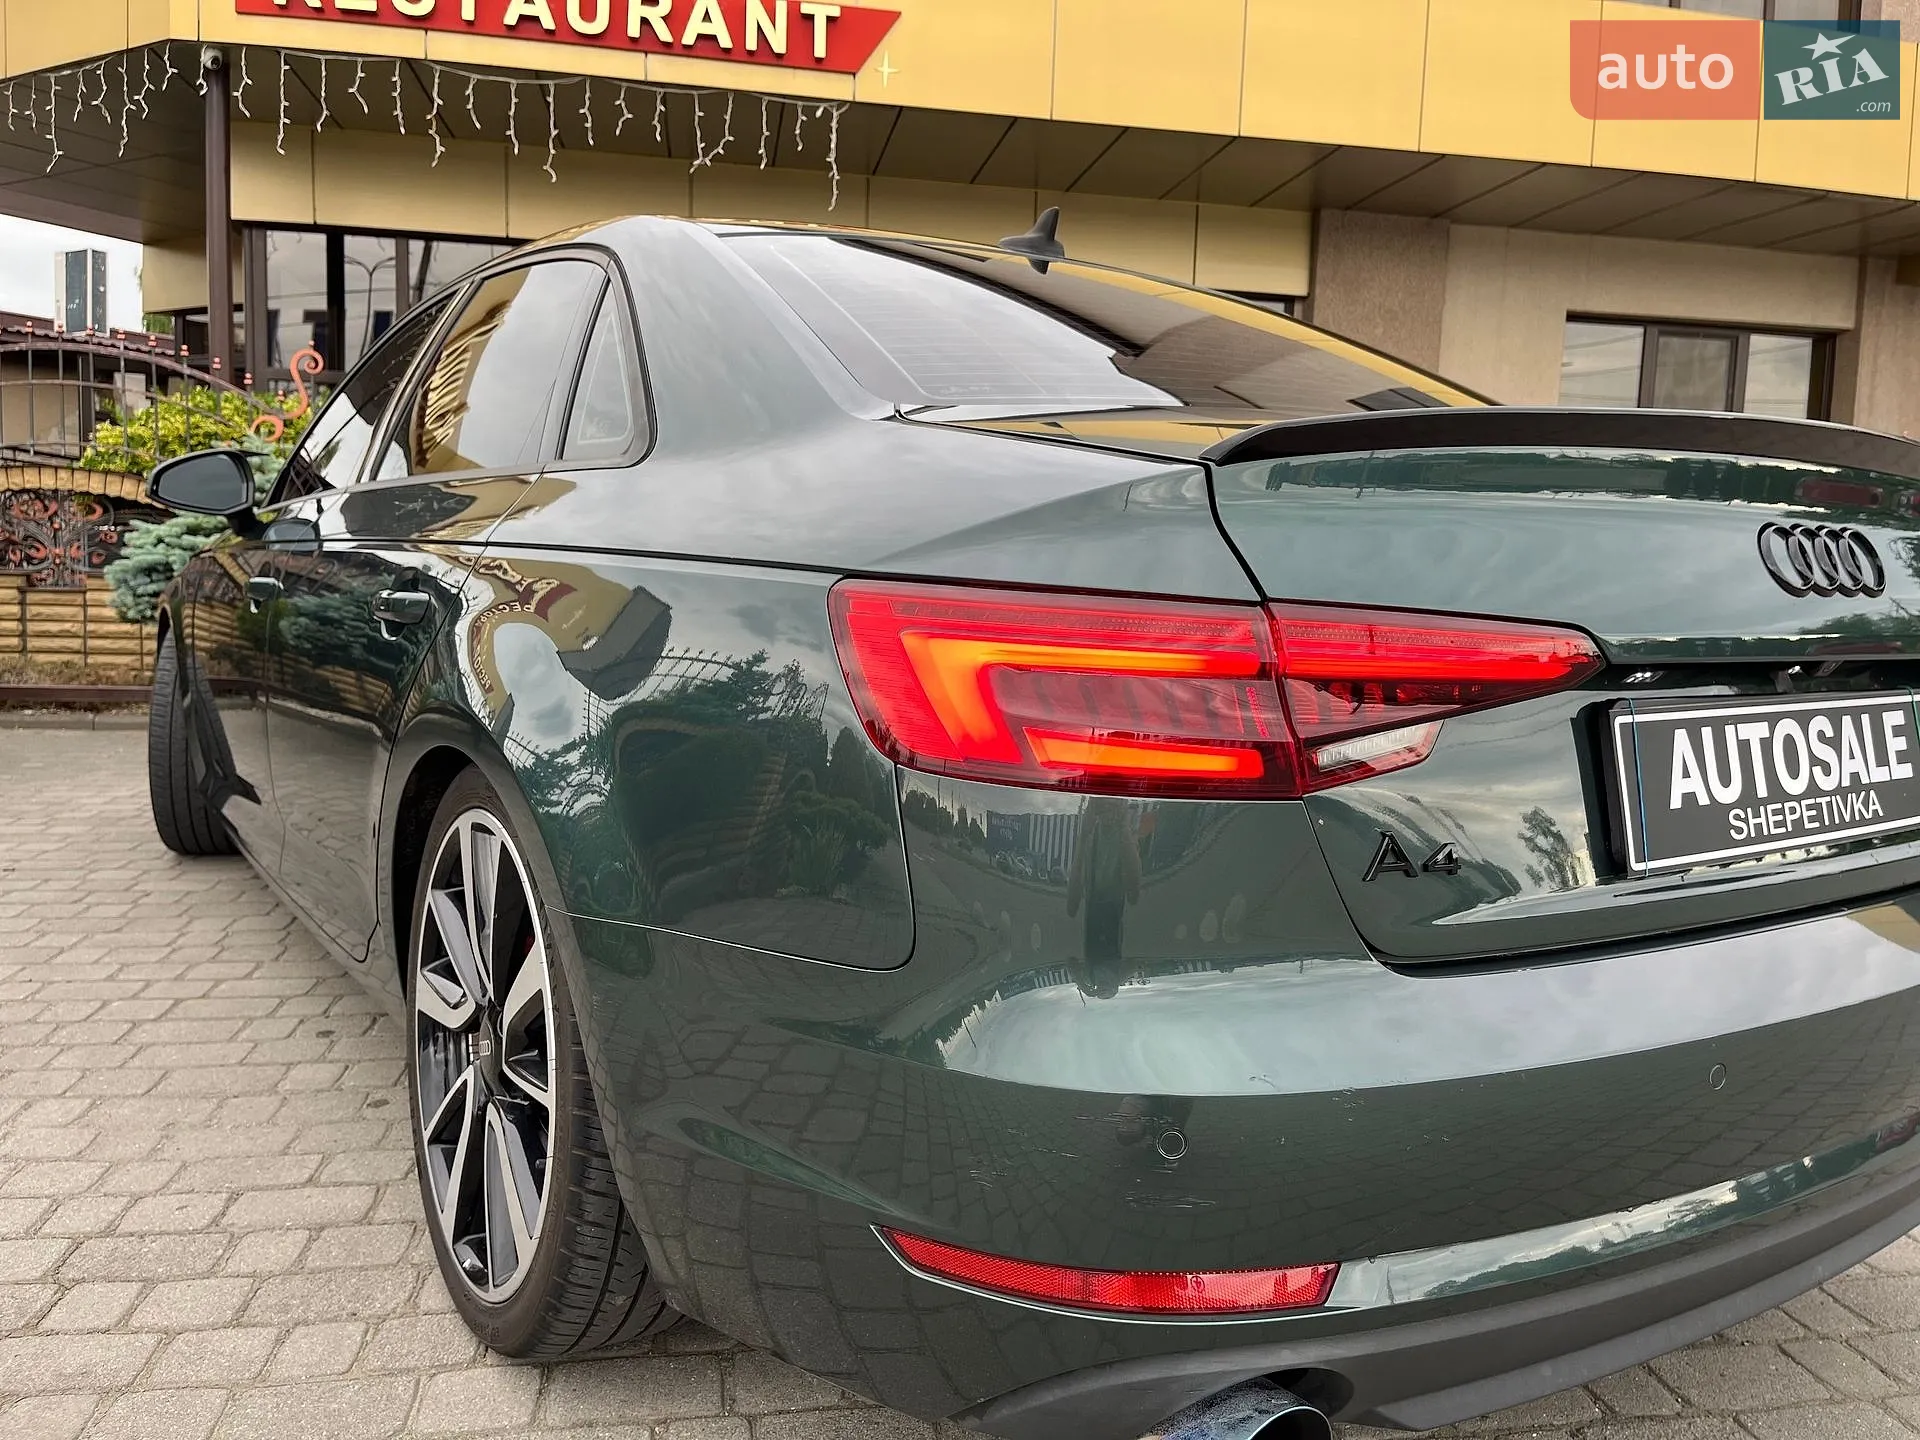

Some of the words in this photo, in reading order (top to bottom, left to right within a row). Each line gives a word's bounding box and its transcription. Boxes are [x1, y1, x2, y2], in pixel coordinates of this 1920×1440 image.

[1669, 709, 1914, 810] AUTOSALE
[1728, 789, 1884, 841] SHEPETIVKA
[1361, 829, 1462, 882] A4
